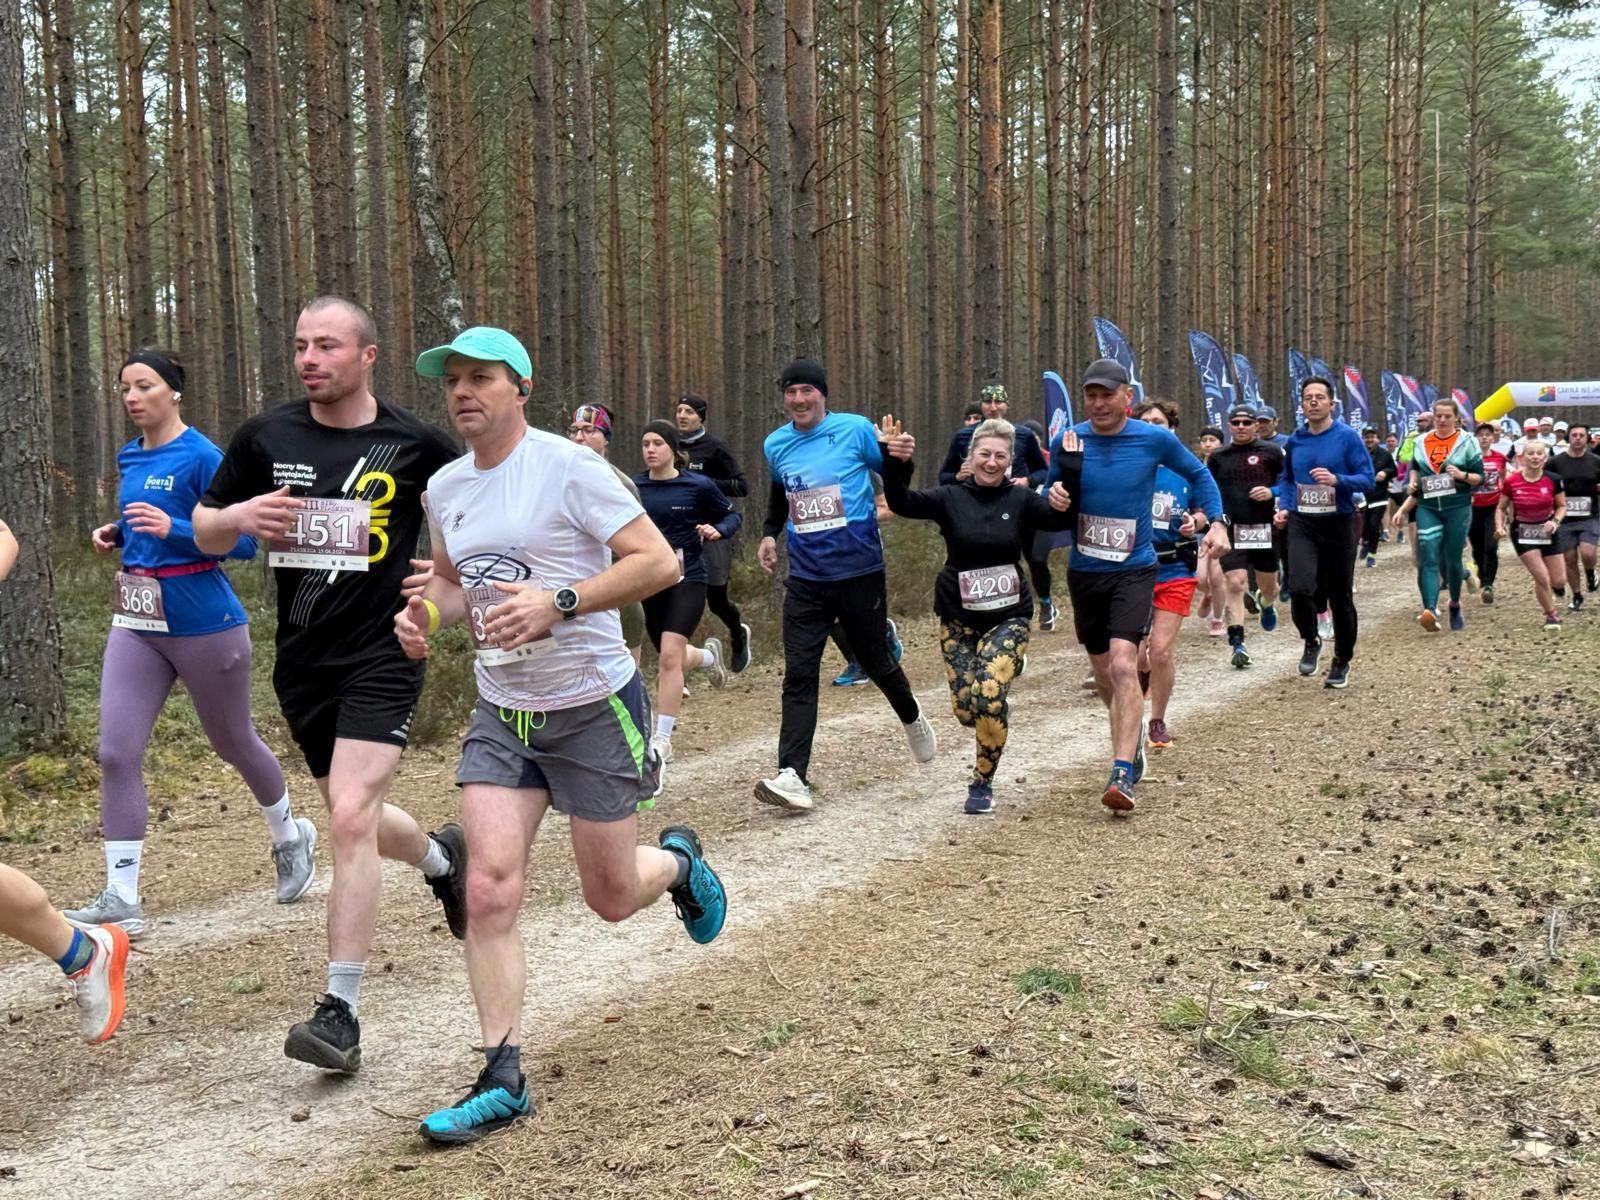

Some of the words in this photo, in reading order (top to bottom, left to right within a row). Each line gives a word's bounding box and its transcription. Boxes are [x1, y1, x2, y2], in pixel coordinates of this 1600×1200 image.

[273, 462, 296, 471] Nocny
[296, 463, 313, 472] Bieg
[796, 496, 835, 520] 343
[1301, 490, 1329, 504] 484
[283, 512, 355, 549] 451
[1084, 525, 1127, 548] 419
[1239, 529, 1266, 541] 524
[969, 574, 1012, 599] 420
[120, 585, 155, 614] 368
